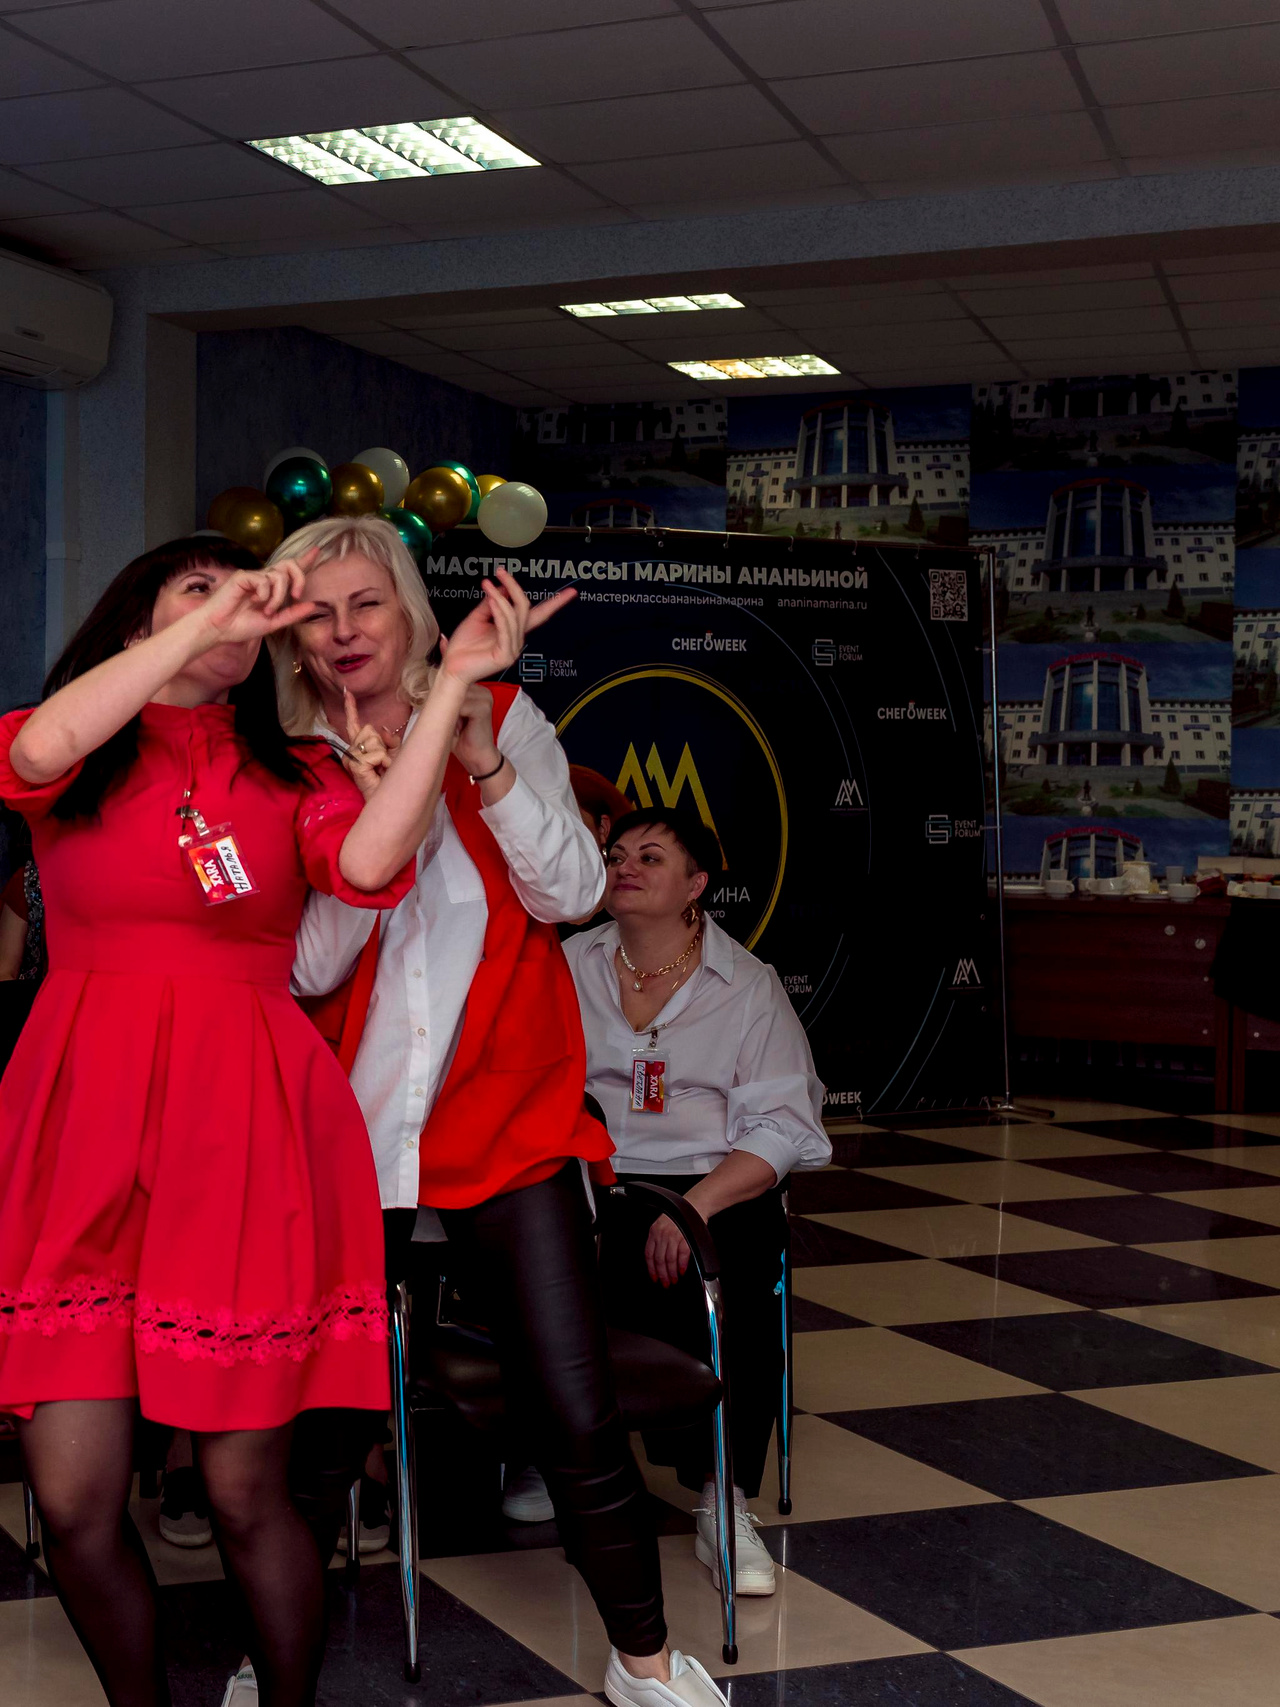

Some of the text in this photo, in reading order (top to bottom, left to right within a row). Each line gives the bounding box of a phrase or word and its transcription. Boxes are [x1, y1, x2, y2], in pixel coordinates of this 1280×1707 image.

[427, 555, 868, 589] МАСТЕР-КЛАССЫ МАРИНЫ АНАНЬИНОЙ
[579, 590, 764, 607] #мастерклассыананьинамарина
[777, 596, 868, 610] ananinamarina.ru
[838, 645, 859, 653] EVENT
[838, 653, 863, 662] FORUM
[549, 660, 574, 669] EVENT
[549, 668, 578, 677] FORUM
[954, 820, 977, 829] EVENT
[954, 829, 981, 838] FORUM
[783, 975, 809, 984] EVENT
